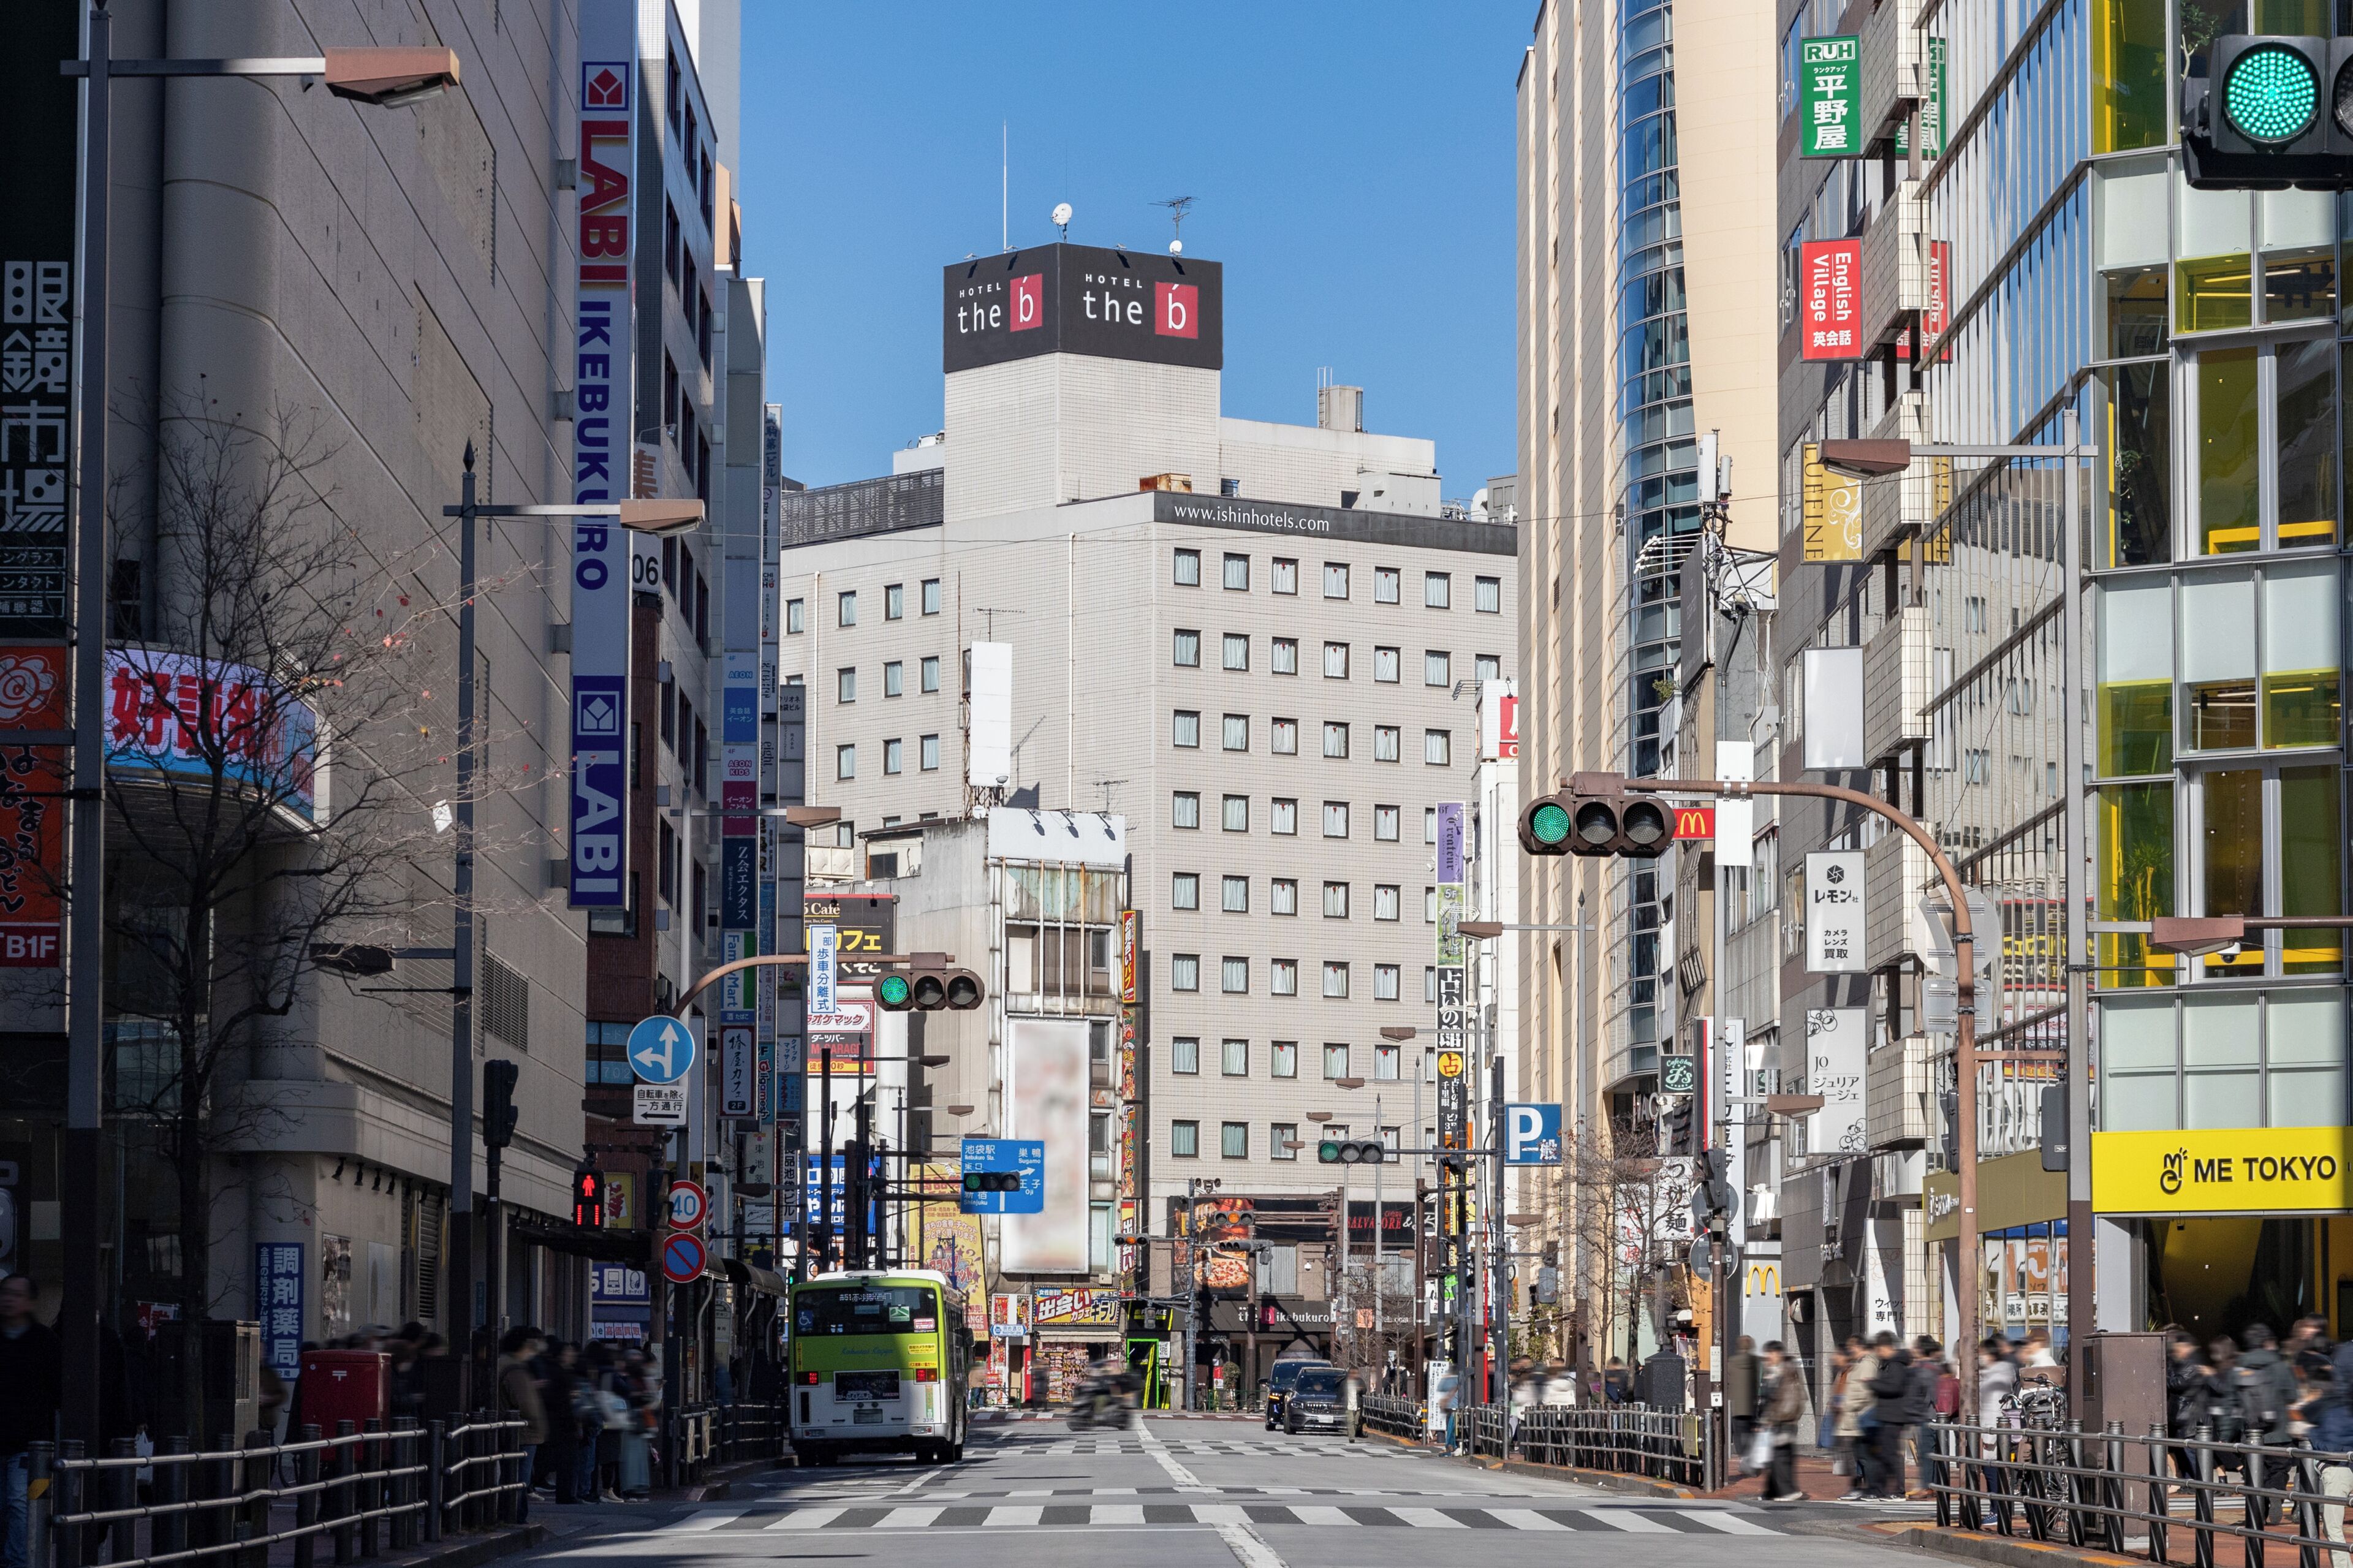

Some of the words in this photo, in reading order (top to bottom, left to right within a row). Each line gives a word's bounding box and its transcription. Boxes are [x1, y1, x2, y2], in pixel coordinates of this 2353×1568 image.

[1807, 44, 1853, 60] RUH
[1813, 74, 1849, 150] 平野屋
[580, 120, 629, 281] LABI
[959, 282, 1001, 298] HOTEL
[1085, 273, 1143, 289] HOTEL
[1810, 254, 1829, 322] Village
[1835, 252, 1852, 321] English
[958, 303, 1001, 334] the
[1083, 290, 1143, 325] the
[1813, 330, 1852, 347] 英会話
[1, 260, 69, 532] 眼鏡市場
[576, 301, 611, 590] IKEBUKURO
[1804, 446, 1824, 560] LUFINE
[1174, 506, 1330, 531] www.ishinhotels.com
[728, 670, 753, 679] AEON
[575, 749, 620, 893] LABI
[6, 935, 56, 958] B1F
[1824, 949, 1848, 960] 買取
[727, 934, 740, 1007] FamyMart
[817, 948, 830, 1010] 歩車分離式
[1439, 969, 1462, 1048] 占いの館
[1814, 1056, 1829, 1073] JO
[637, 1089, 684, 1099] 自転車を除く
[757, 1059, 771, 1119] Gilgamesh
[1814, 1077, 1859, 1088] ジュリア
[637, 1101, 683, 1112] 一方通行
[1509, 1107, 1543, 1160] P
[964, 1145, 996, 1155] 池袋駅
[1018, 1148, 1042, 1158] 巣鴨
[2194, 1157, 2234, 1183] ME
[2243, 1155, 2337, 1181] TOKYO
[673, 1195, 697, 1216] 40
[1347, 1216, 1402, 1230] SALVAORE
[271, 1247, 300, 1366] 調剤薬局
[1037, 1290, 1091, 1321] 出会い
[1070, 1309, 1091, 1322] カフェ
[1276, 1311, 1330, 1323] ikebukuro
